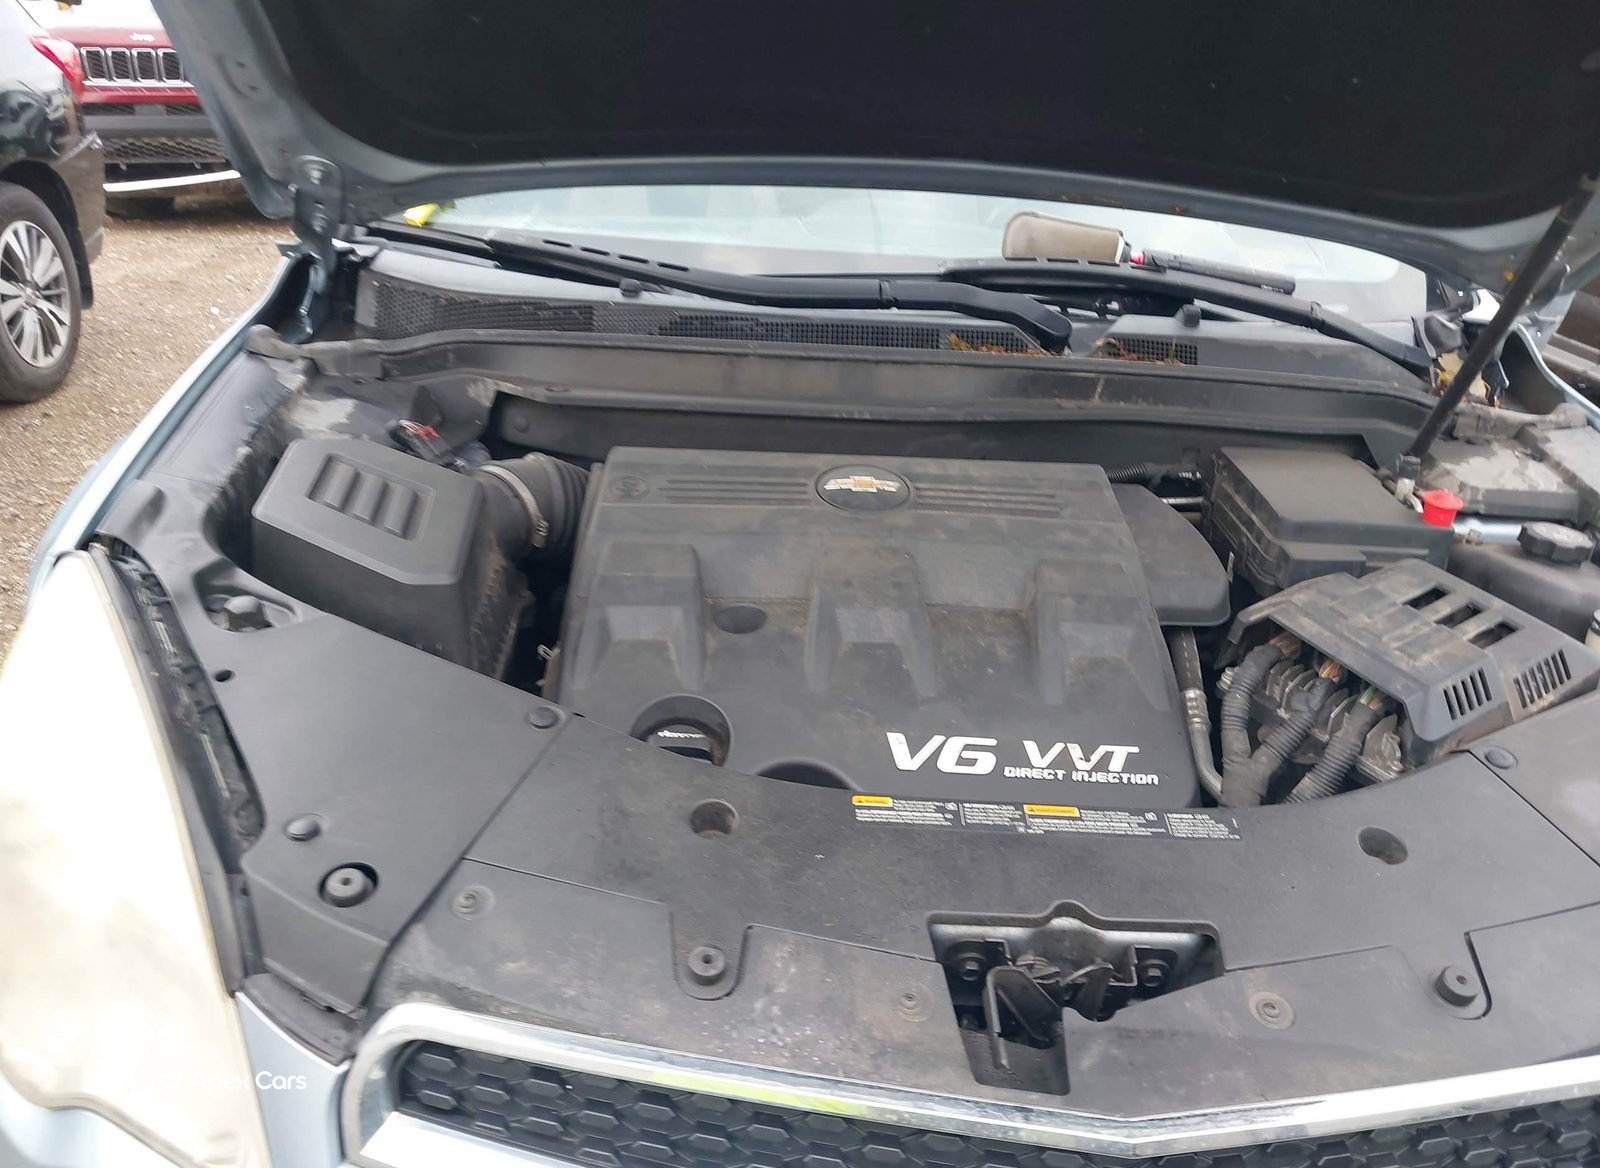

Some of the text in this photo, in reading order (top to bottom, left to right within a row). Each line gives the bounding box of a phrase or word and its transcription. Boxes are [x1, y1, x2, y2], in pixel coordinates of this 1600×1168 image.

[885, 731, 1140, 775] V6 VVT
[1003, 766, 1160, 786] DIRECT INJECTION
